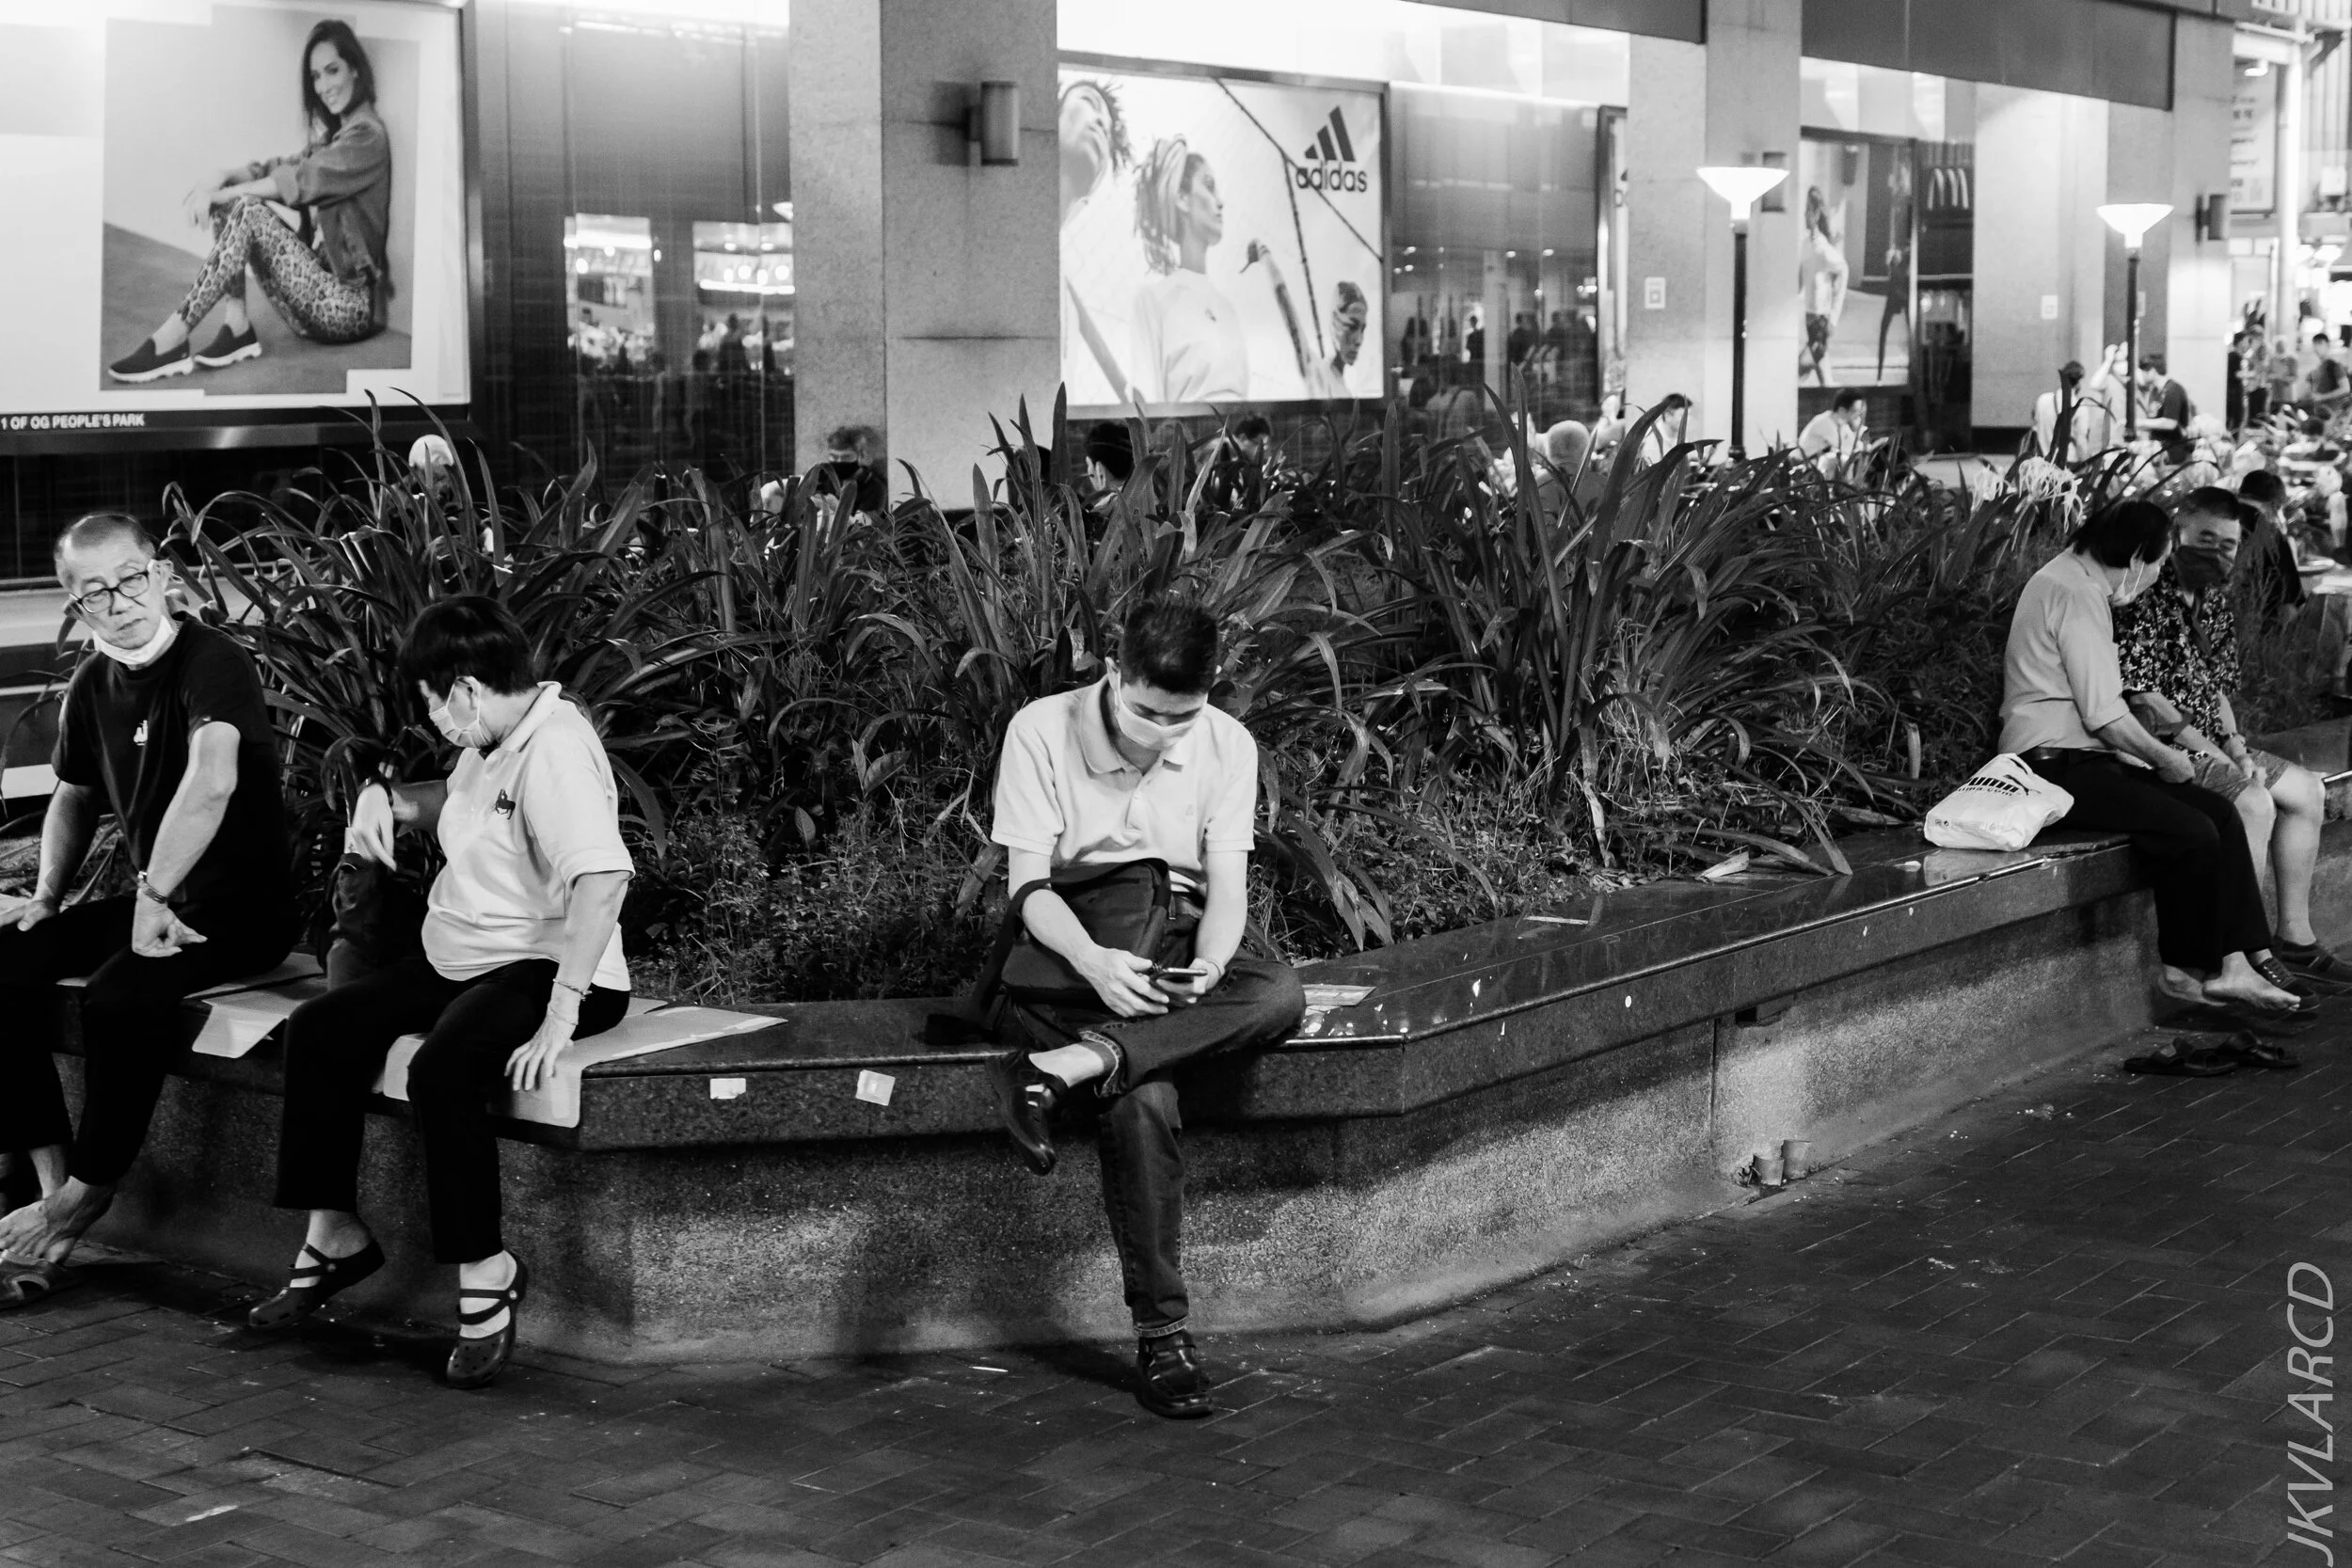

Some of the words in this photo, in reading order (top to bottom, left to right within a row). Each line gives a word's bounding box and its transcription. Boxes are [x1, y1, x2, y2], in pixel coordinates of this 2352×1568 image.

[1296, 159, 1367, 193] adidas
[10, 416, 28, 430] OF
[30, 415, 50, 430] OG
[52, 413, 111, 429] PEOPLE'S
[112, 413, 145, 427] PARK
[1958, 786, 2012, 797] uma.com
